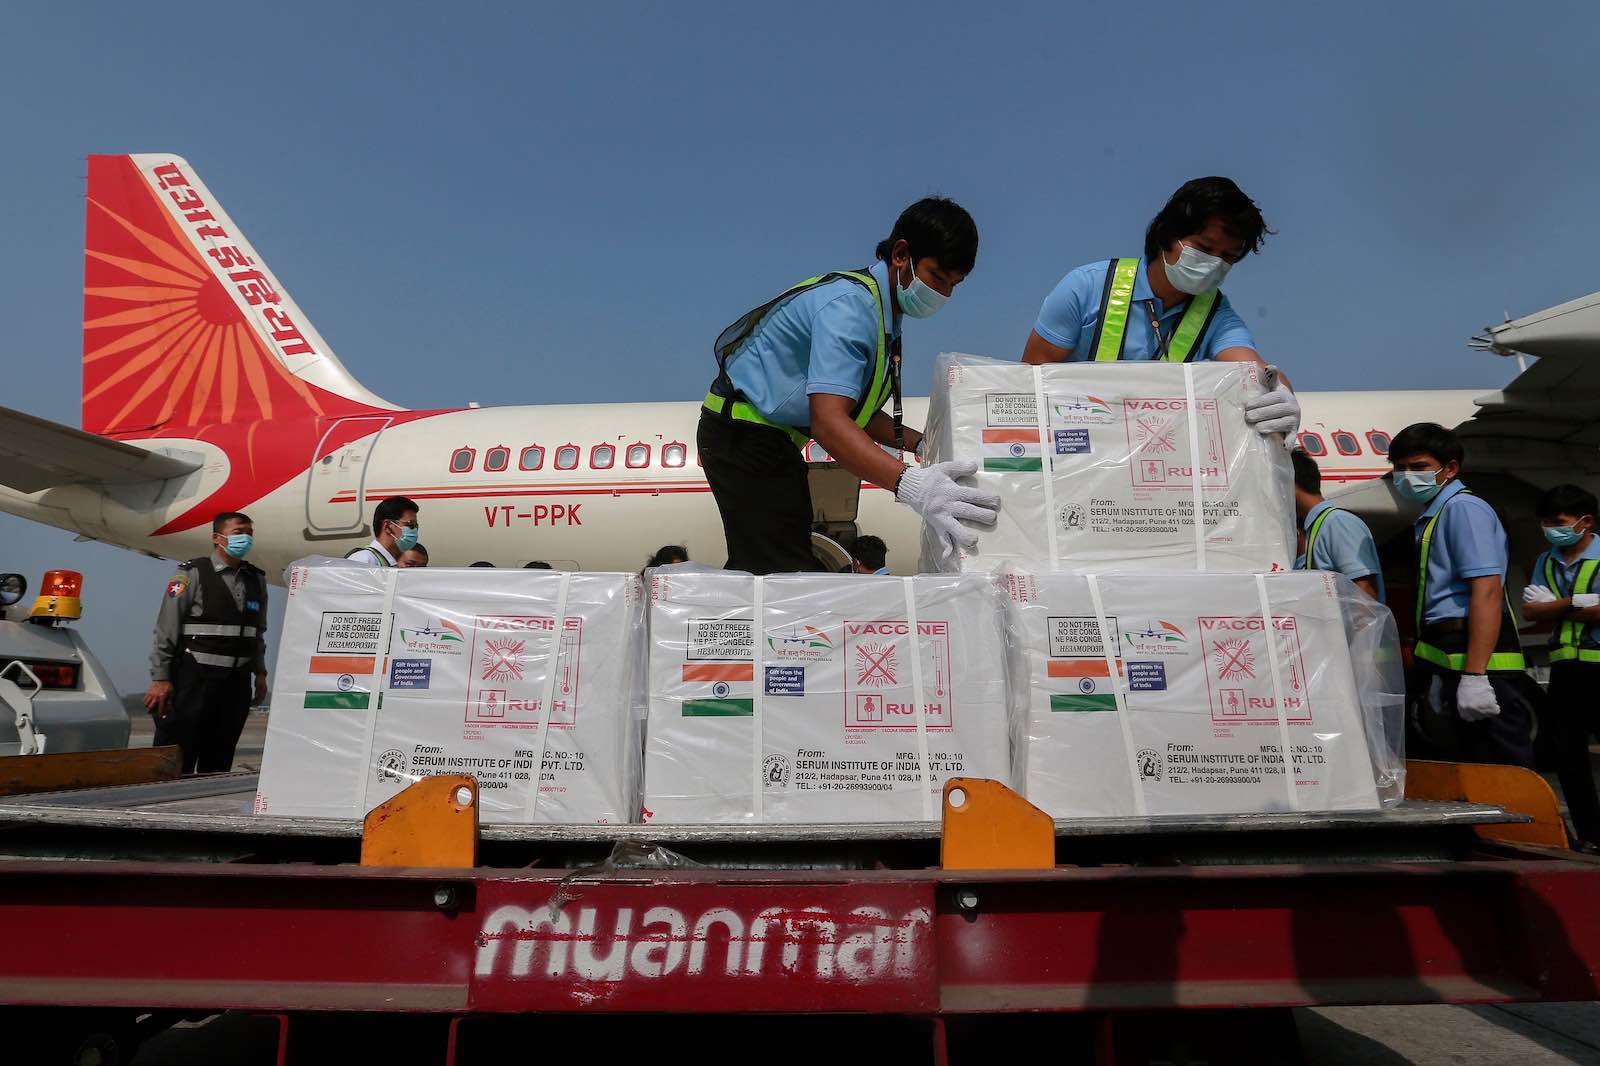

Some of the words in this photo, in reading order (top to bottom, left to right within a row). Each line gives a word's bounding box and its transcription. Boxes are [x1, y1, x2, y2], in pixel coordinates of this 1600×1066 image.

[153, 162, 229, 241] एअर
[207, 245, 317, 357] इंडिया
[1167, 467, 1218, 476] RUH
[484, 503, 582, 527] VT-PPK
[847, 624, 946, 636] VACCNE
[508, 699, 567, 712] RUH
[1248, 697, 1301, 709] RUH
[886, 703, 942, 715] RUH
[414, 745, 443, 754] From:
[1167, 743, 1194, 752] From:
[1260, 745, 1280, 753] MFG.
[1296, 745, 1313, 753] NO.:
[1314, 745, 1323, 753] 10
[555, 751, 572, 759] NO.:
[574, 752, 584, 760] 10
[797, 749, 825, 758] From:
[896, 752, 916, 760] MFG.
[935, 753, 952, 761] NO.:
[412, 756, 446, 767] SERUM
[447, 757, 498, 768] INSTITUTE
[499, 759, 511, 769] OF
[513, 759, 533, 769] INDI
[541, 761, 562, 770] PVT.
[564, 761, 585, 771] LTD.
[1167, 754, 1199, 763] SERUM
[1200, 754, 1245, 763] INSTITUTE
[1247, 755, 1260, 763] OF
[1261, 755, 1285, 763] INDIA
[1291, 755, 1306, 763] VT.
[1308, 755, 1326, 764] LTD.
[795, 761, 829, 770] SERUM
[831, 761, 878, 771] INSTITUTE
[880, 761, 893, 771] OF
[895, 762, 921, 771] INDIA
[928, 762, 943, 771] VT.
[945, 762, 965, 772] LTD.
[1168, 766, 1190, 775] 212/2,
[1191, 767, 1229, 775] Hadapsar,
[1230, 767, 1249, 775] Pune
[1250, 767, 1263, 775] 411
[1264, 767, 1280, 776] 028,
[477, 771, 497, 779] Pune
[498, 771, 512, 780] 411
[514, 772, 531, 781] 028,
[795, 773, 818, 781] 212/2,
[820, 773, 860, 782] Hadapsar,
[898, 774, 914, 783] 028,
[1169, 776, 1189, 784] TEL.:
[795, 782, 816, 790] TEL.:
